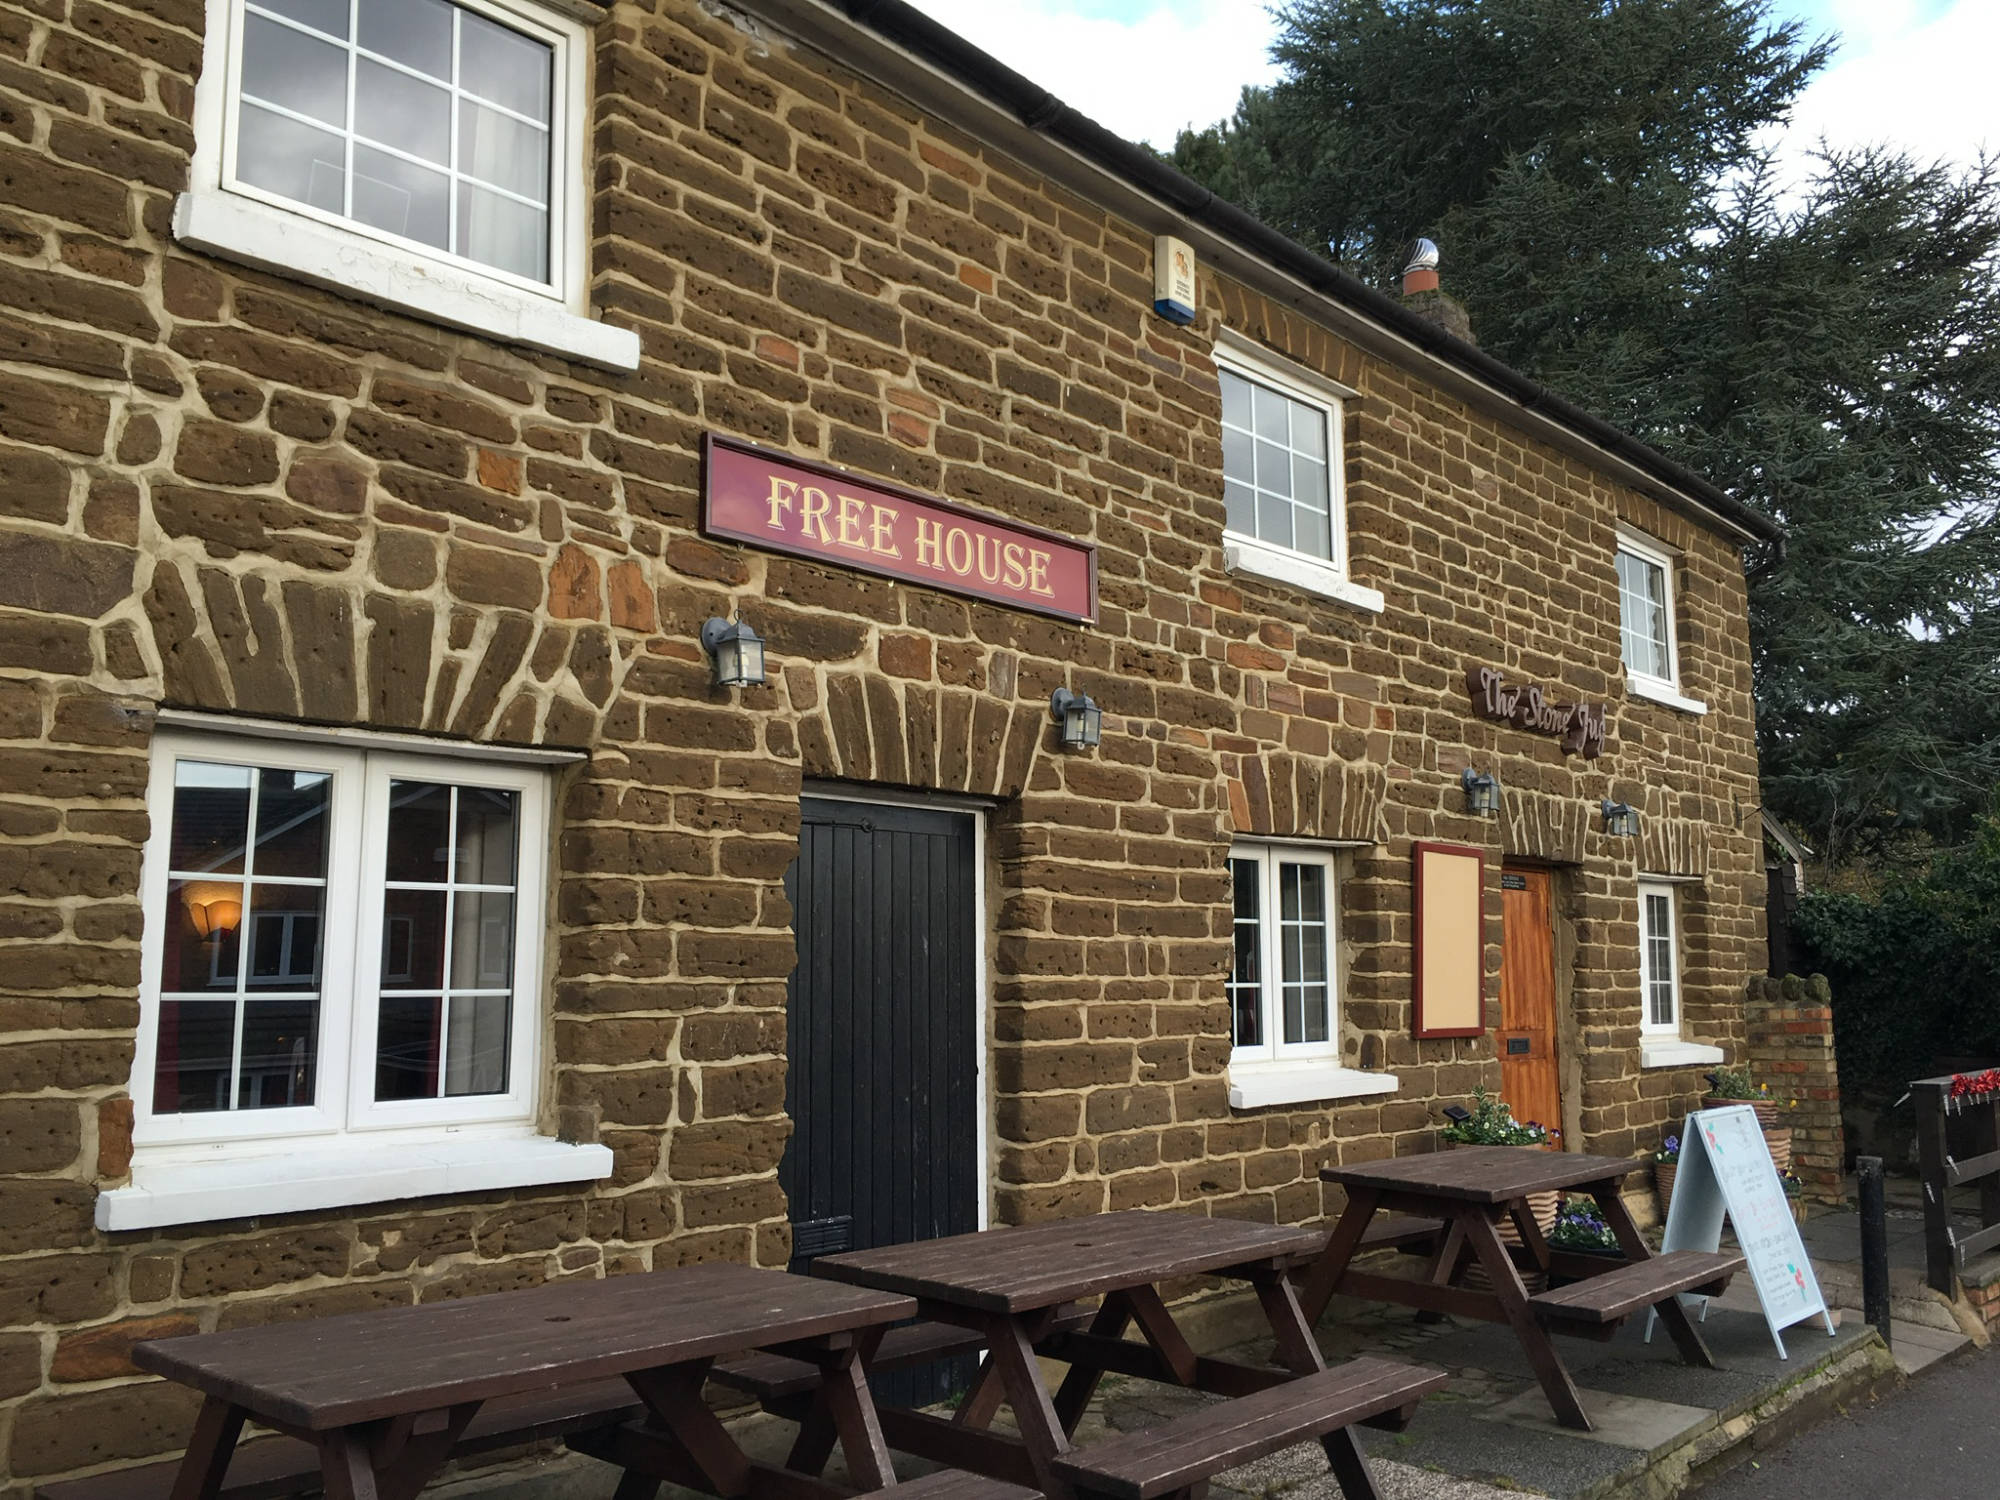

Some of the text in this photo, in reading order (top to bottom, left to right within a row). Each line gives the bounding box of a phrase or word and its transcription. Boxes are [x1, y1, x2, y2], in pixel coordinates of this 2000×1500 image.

[766, 475, 1055, 598] FREE HOUSE
[1481, 667, 1608, 757] The Stone Jug
